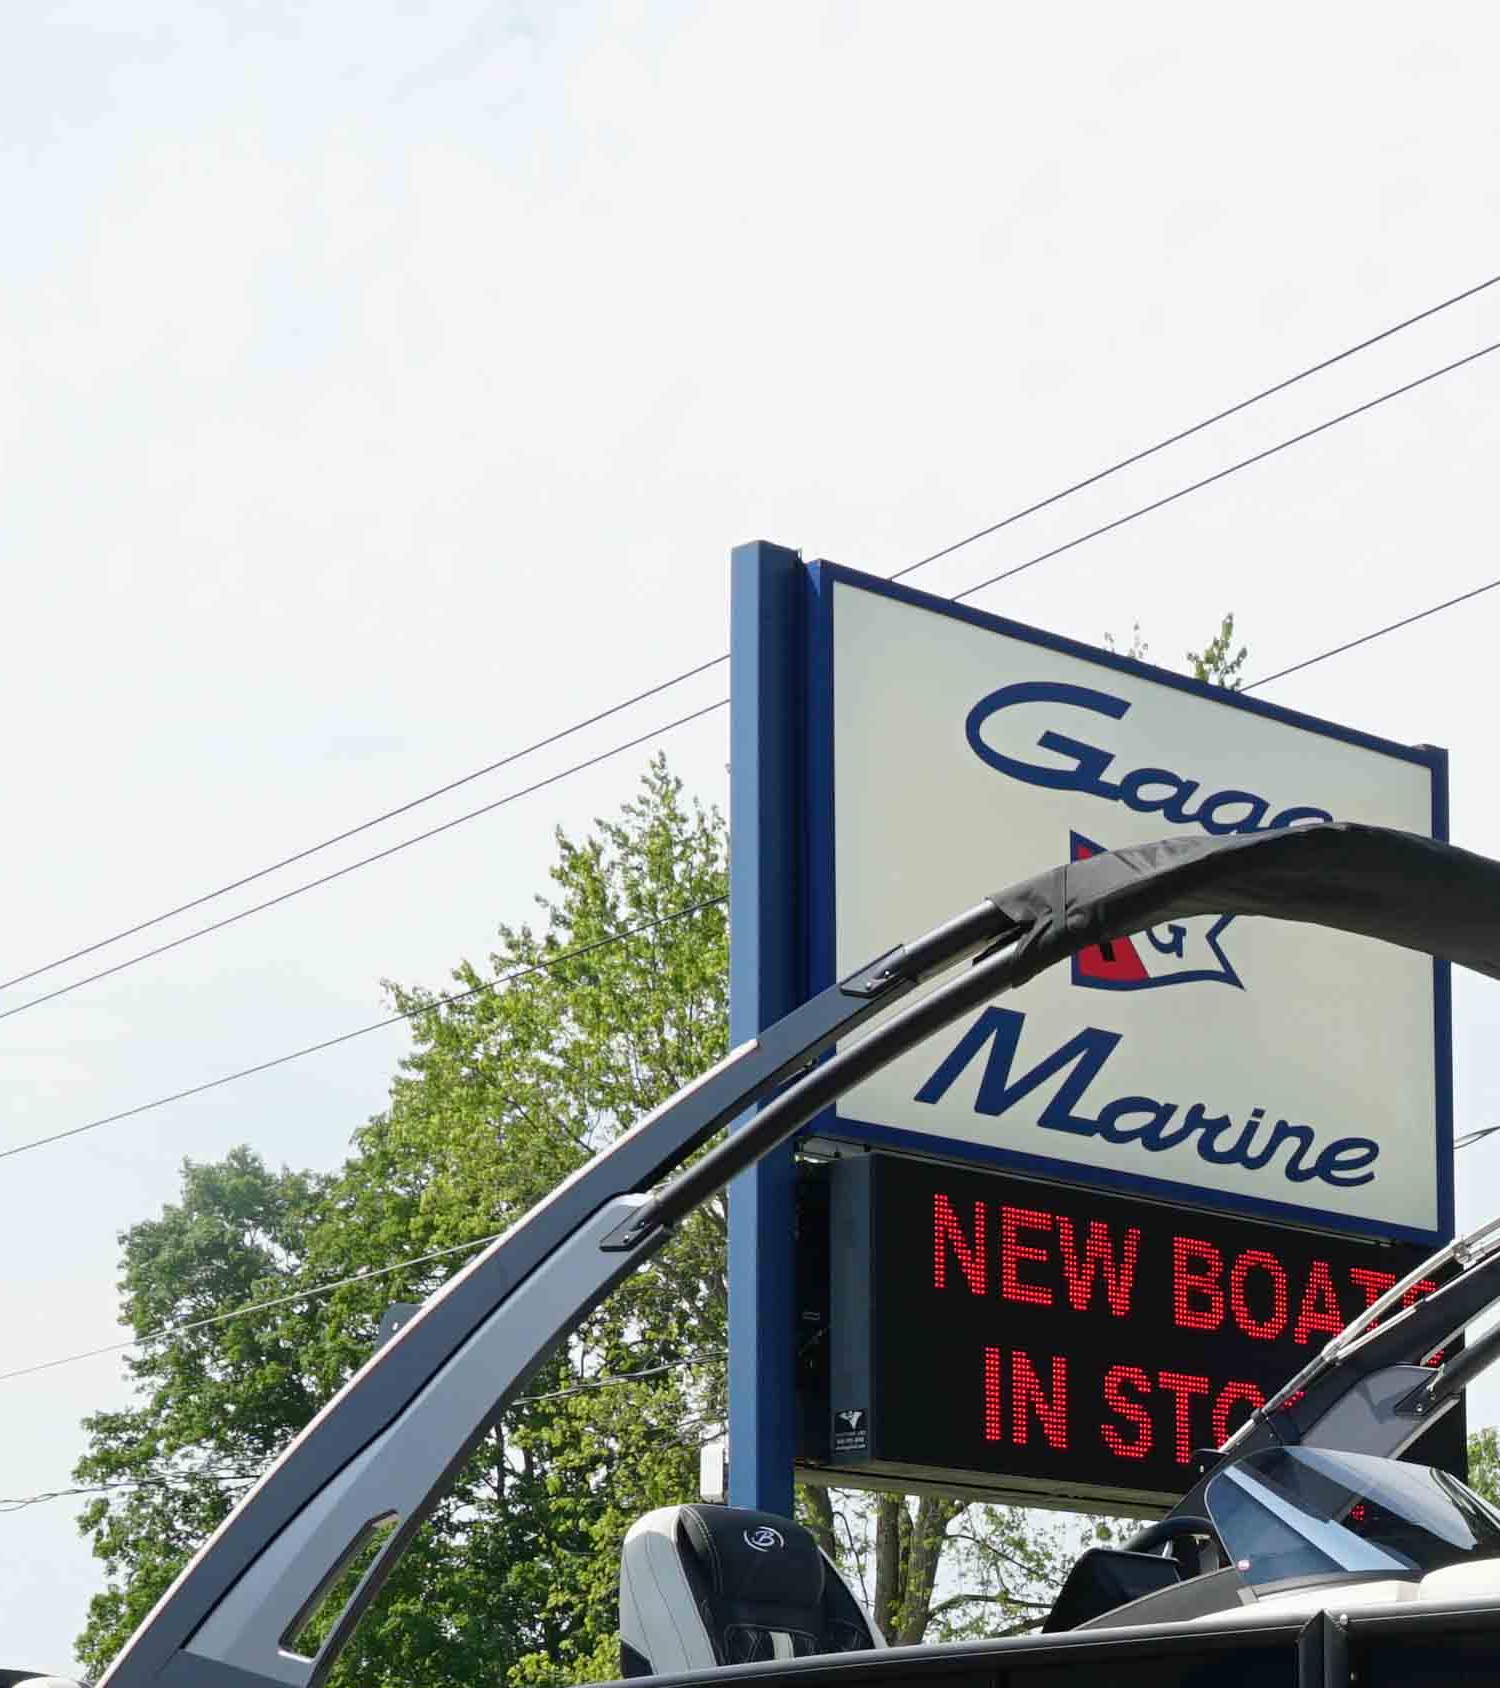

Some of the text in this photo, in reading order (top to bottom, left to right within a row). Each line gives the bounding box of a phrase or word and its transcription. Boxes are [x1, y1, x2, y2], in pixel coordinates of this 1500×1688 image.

[913, 1005, 1380, 1187] Marine
[933, 1192, 1142, 1318] NEW
[984, 1345, 1069, 1449] IN
